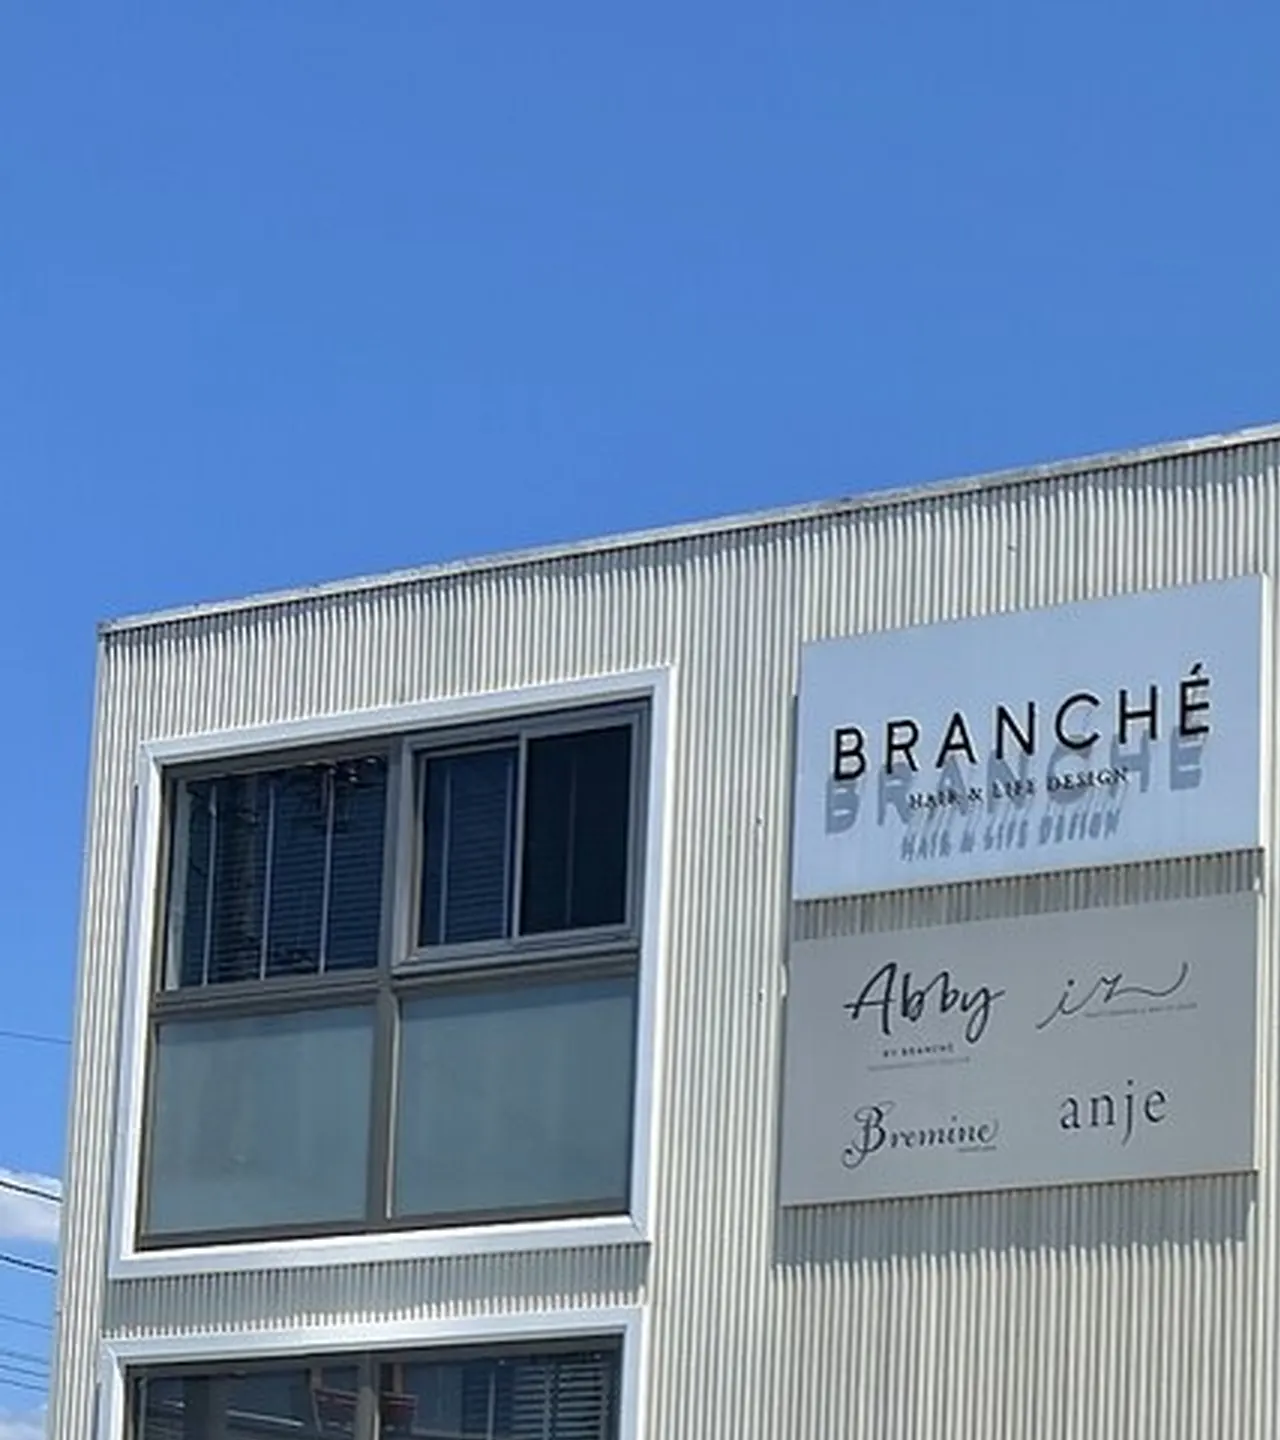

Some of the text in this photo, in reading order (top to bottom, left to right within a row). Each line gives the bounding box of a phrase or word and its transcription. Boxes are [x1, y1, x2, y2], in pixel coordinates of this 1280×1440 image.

[833, 662, 1210, 781] BRANCHÉ
[908, 789, 962, 811] HAIR
[1047, 766, 1130, 792] DESIGN
[843, 961, 1006, 1044] Abby
[841, 1101, 999, 1170] Bremine
[1060, 1079, 1166, 1147] anje
